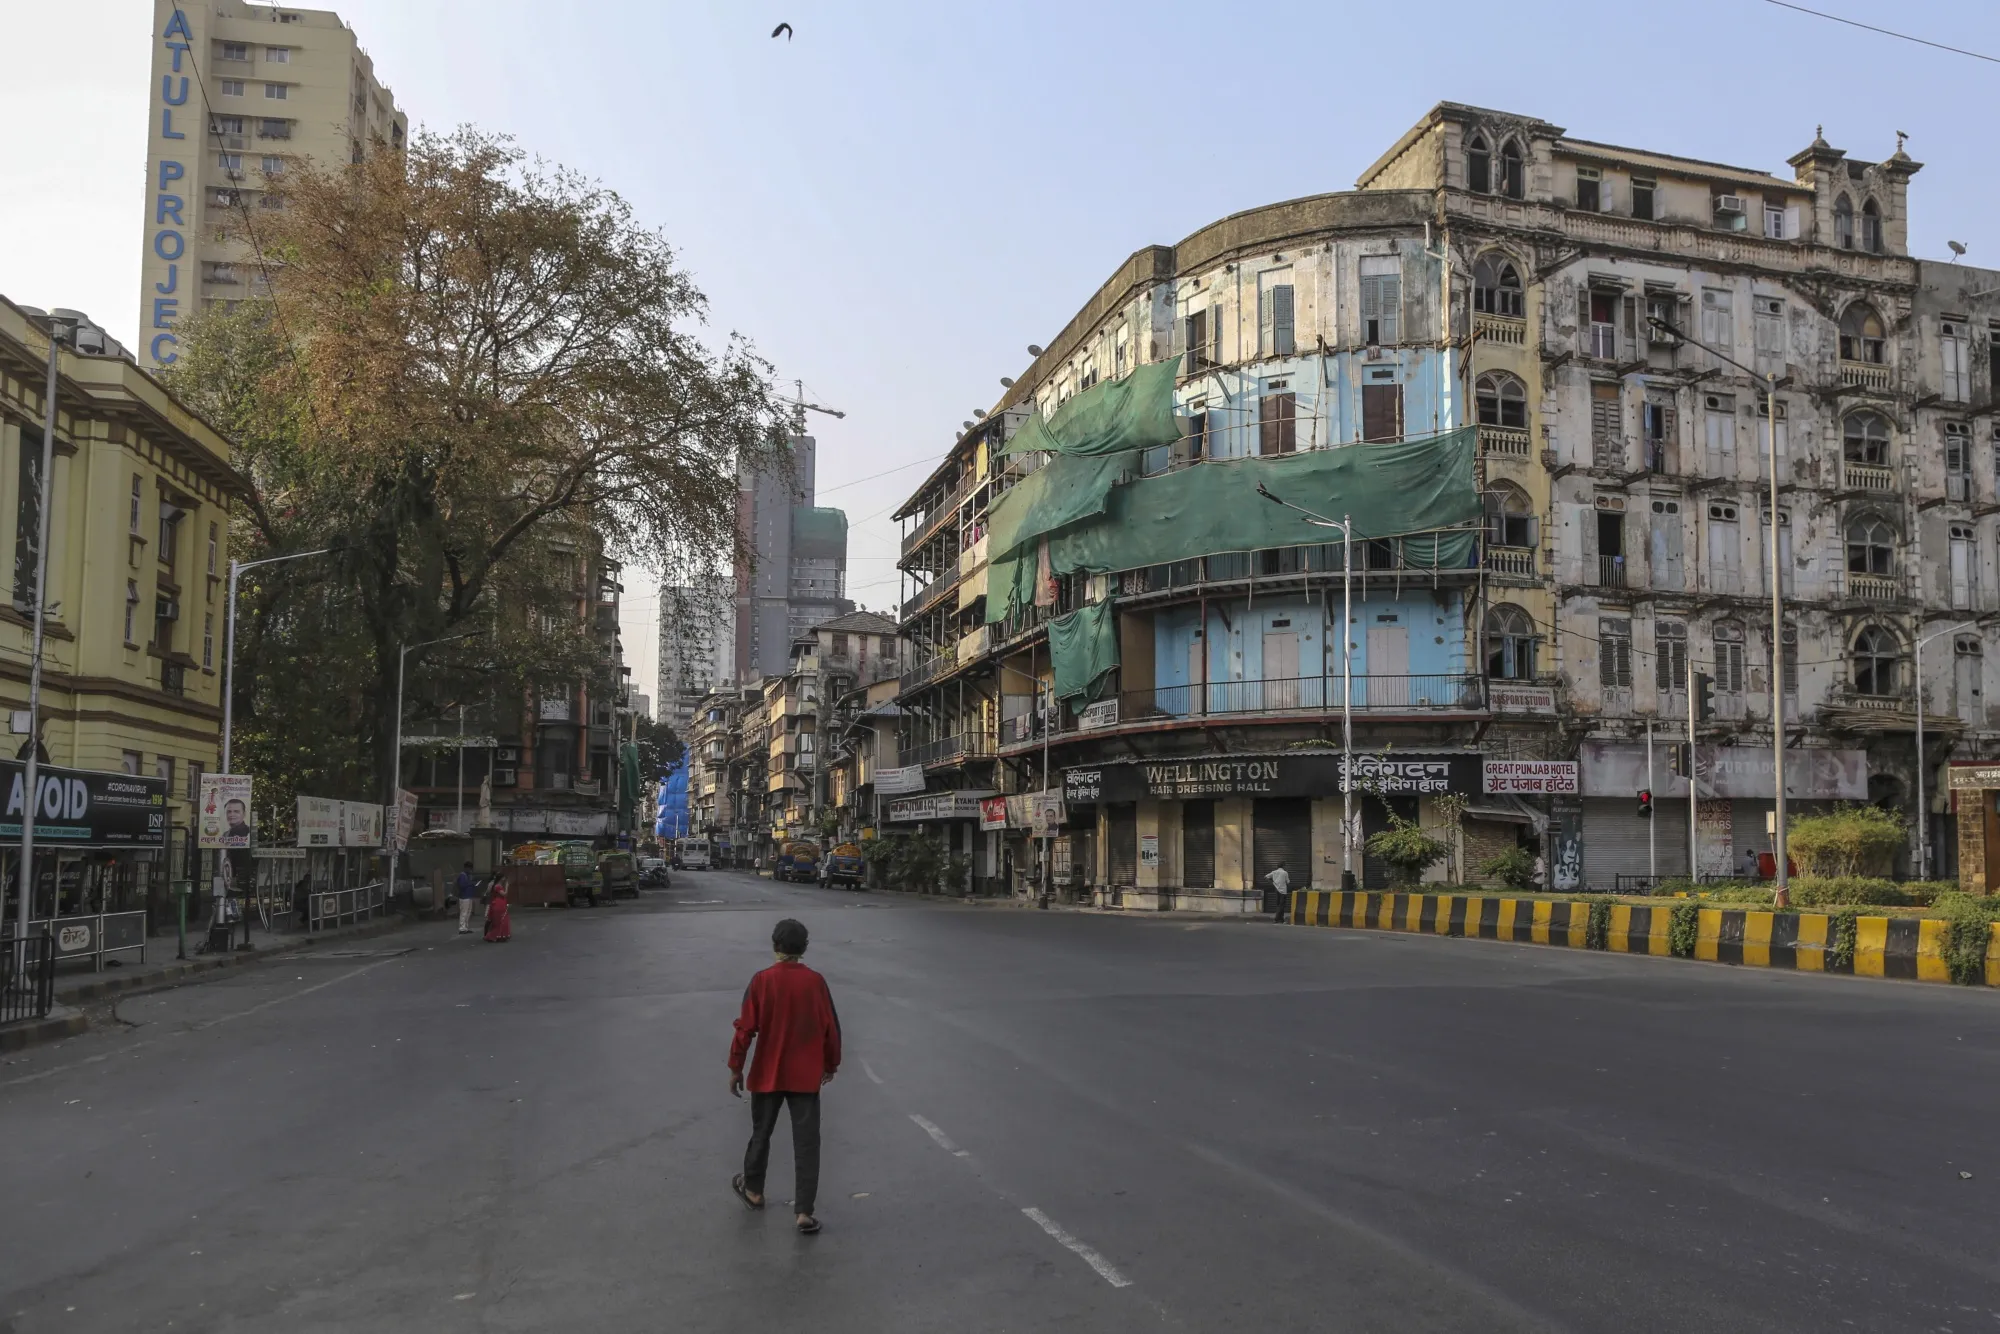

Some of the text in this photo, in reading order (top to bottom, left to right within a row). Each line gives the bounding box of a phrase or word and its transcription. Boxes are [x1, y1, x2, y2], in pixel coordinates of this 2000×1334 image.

[150, 9, 194, 366] ATUL PROJEC
[1524, 695, 1551, 707] STUDIO
[1100, 703, 1116, 715] STUDIO
[1146, 761, 1280, 784] WELLINGTON
[1485, 763, 1576, 775] GREAT PUNJAB HOTEL
[1066, 769, 1101, 786] वेलिंगटन
[107, 782, 147, 794] #CORONAVIRUS
[1150, 782, 1271, 795] HAIR DRESSING HALL
[1417, 776, 1449, 793] हॉल
[1487, 775, 1575, 793] ग्रेट पंजाब हॉटेल
[152, 794, 164, 806] 1916
[955, 797, 974, 805] KYANI
[1696, 800, 1731, 812] IANOS
[148, 813, 164, 828] DSP
[1698, 820, 1732, 830] UITARS
